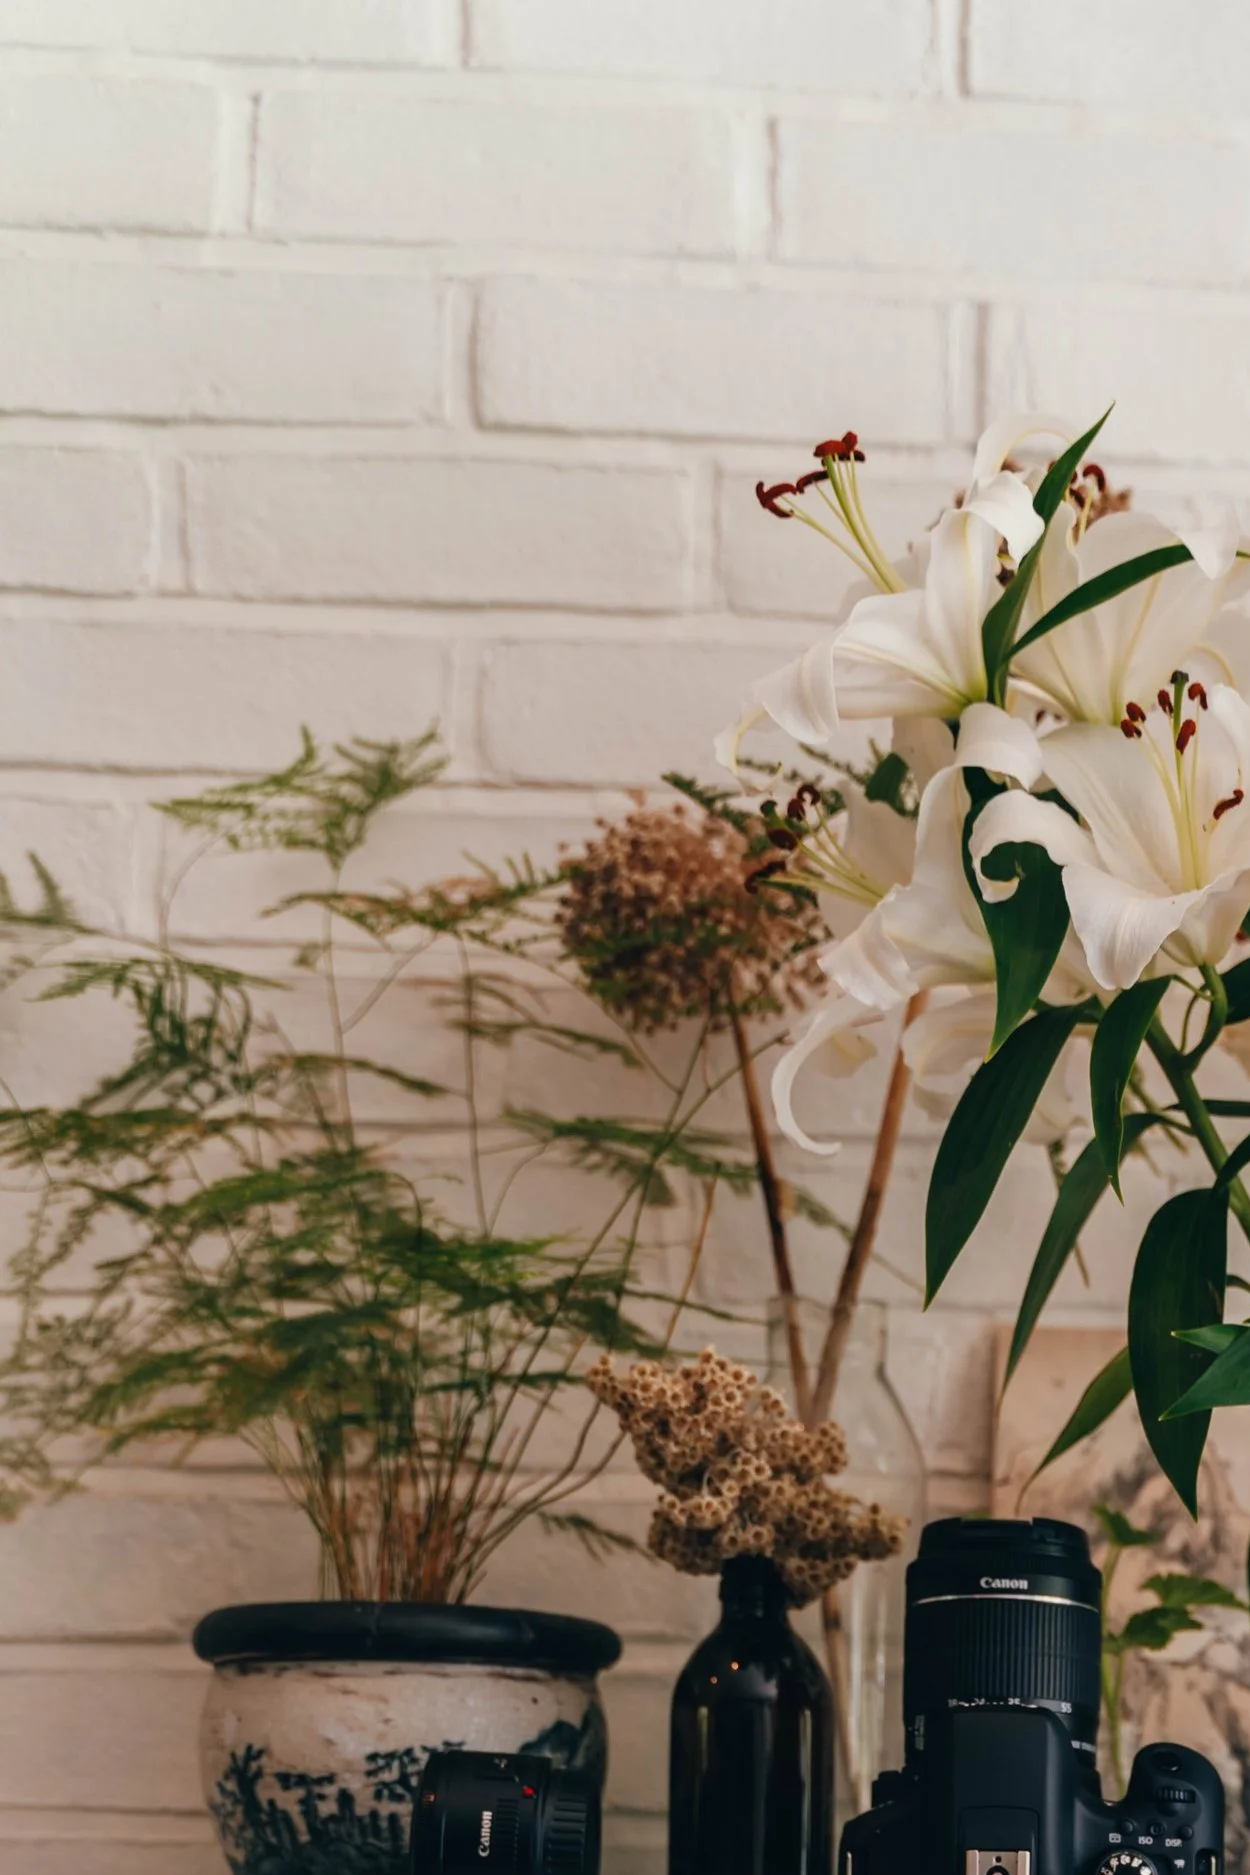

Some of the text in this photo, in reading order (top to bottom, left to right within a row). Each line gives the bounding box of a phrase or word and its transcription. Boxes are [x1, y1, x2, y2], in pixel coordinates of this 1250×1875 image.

[979, 1576, 1029, 1590] Canon
[477, 1810, 493, 1858] Canon
[1138, 1836, 1153, 1845] ISO
